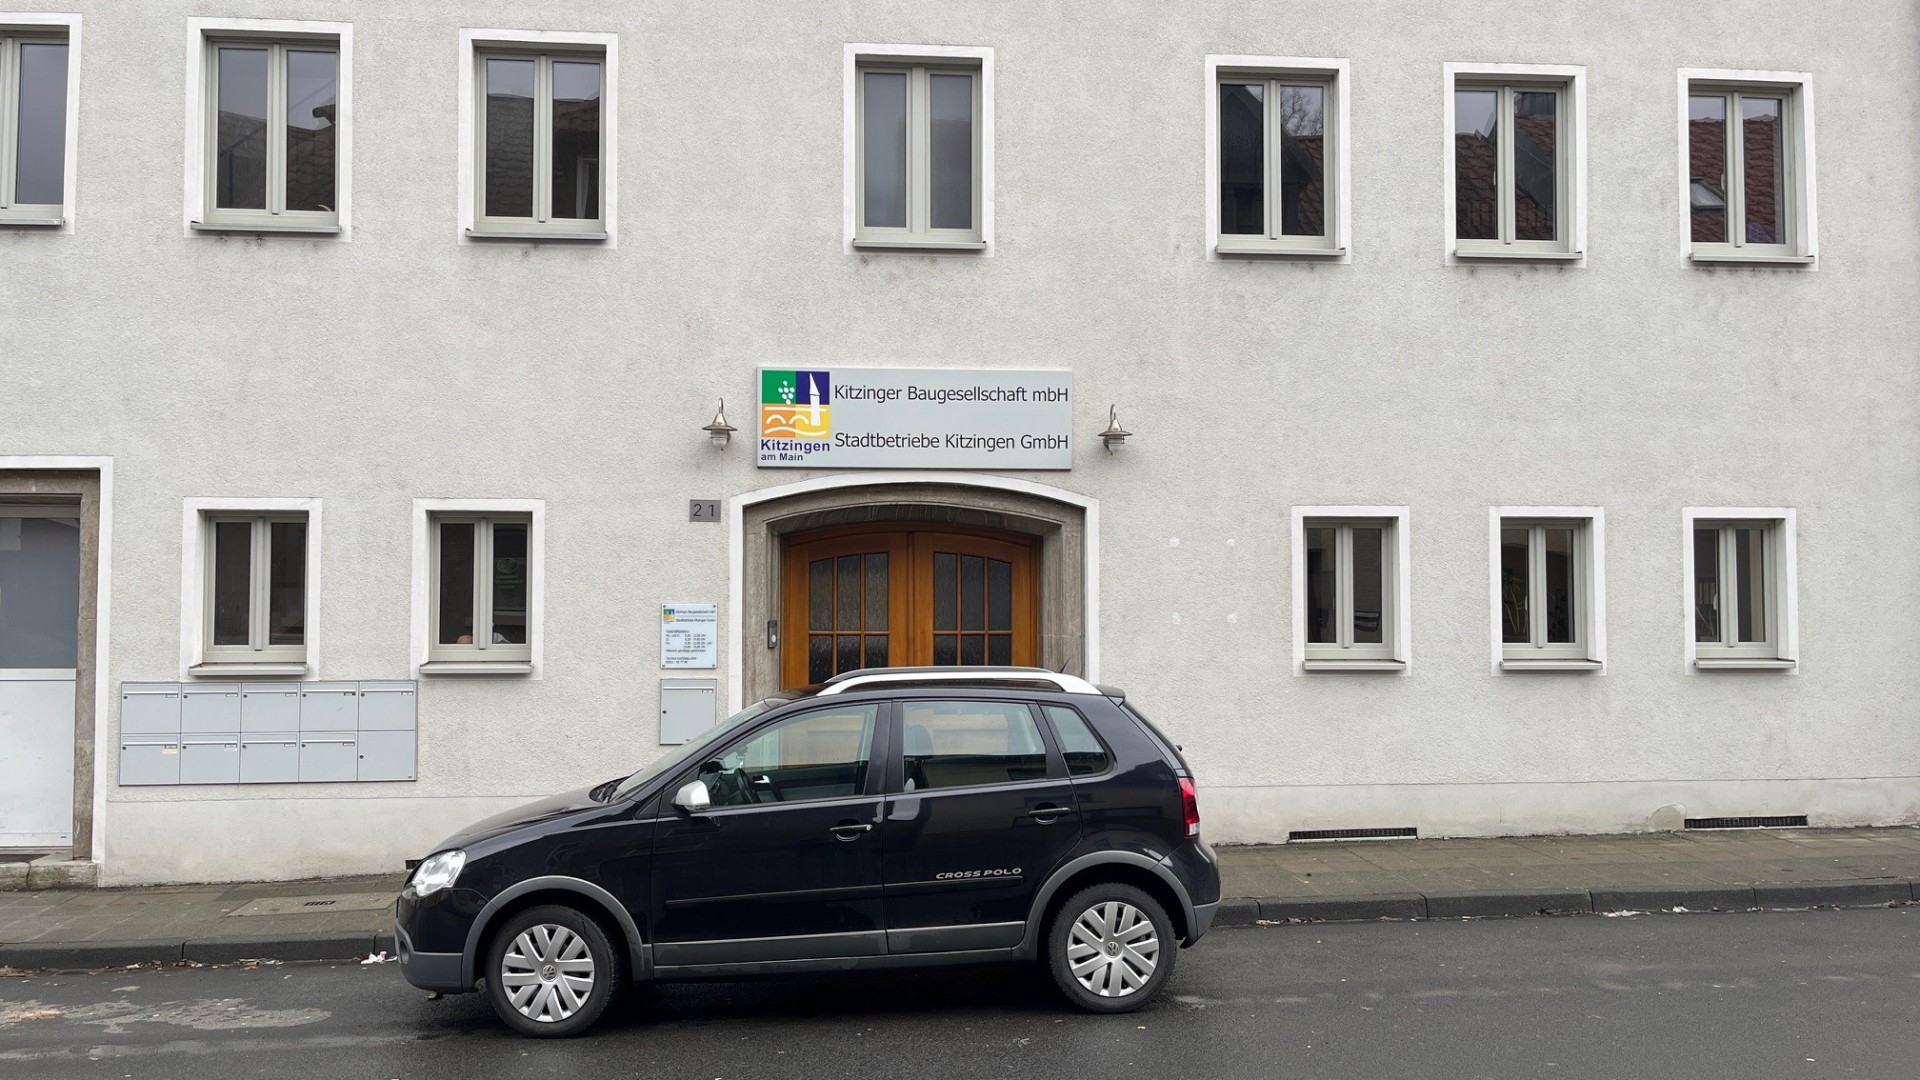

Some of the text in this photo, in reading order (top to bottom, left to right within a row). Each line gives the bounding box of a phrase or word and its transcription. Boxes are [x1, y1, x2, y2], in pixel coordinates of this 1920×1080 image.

[835, 384, 1069, 405] Kitzinger Baugesellschaft mbH
[760, 438, 831, 455] Kitzingen
[835, 431, 1069, 453] Stadtbetriebe Kitzingen GmbH
[761, 452, 804, 461] am Main
[693, 503, 715, 517] 21
[936, 867, 1022, 880] CROSS POLO
